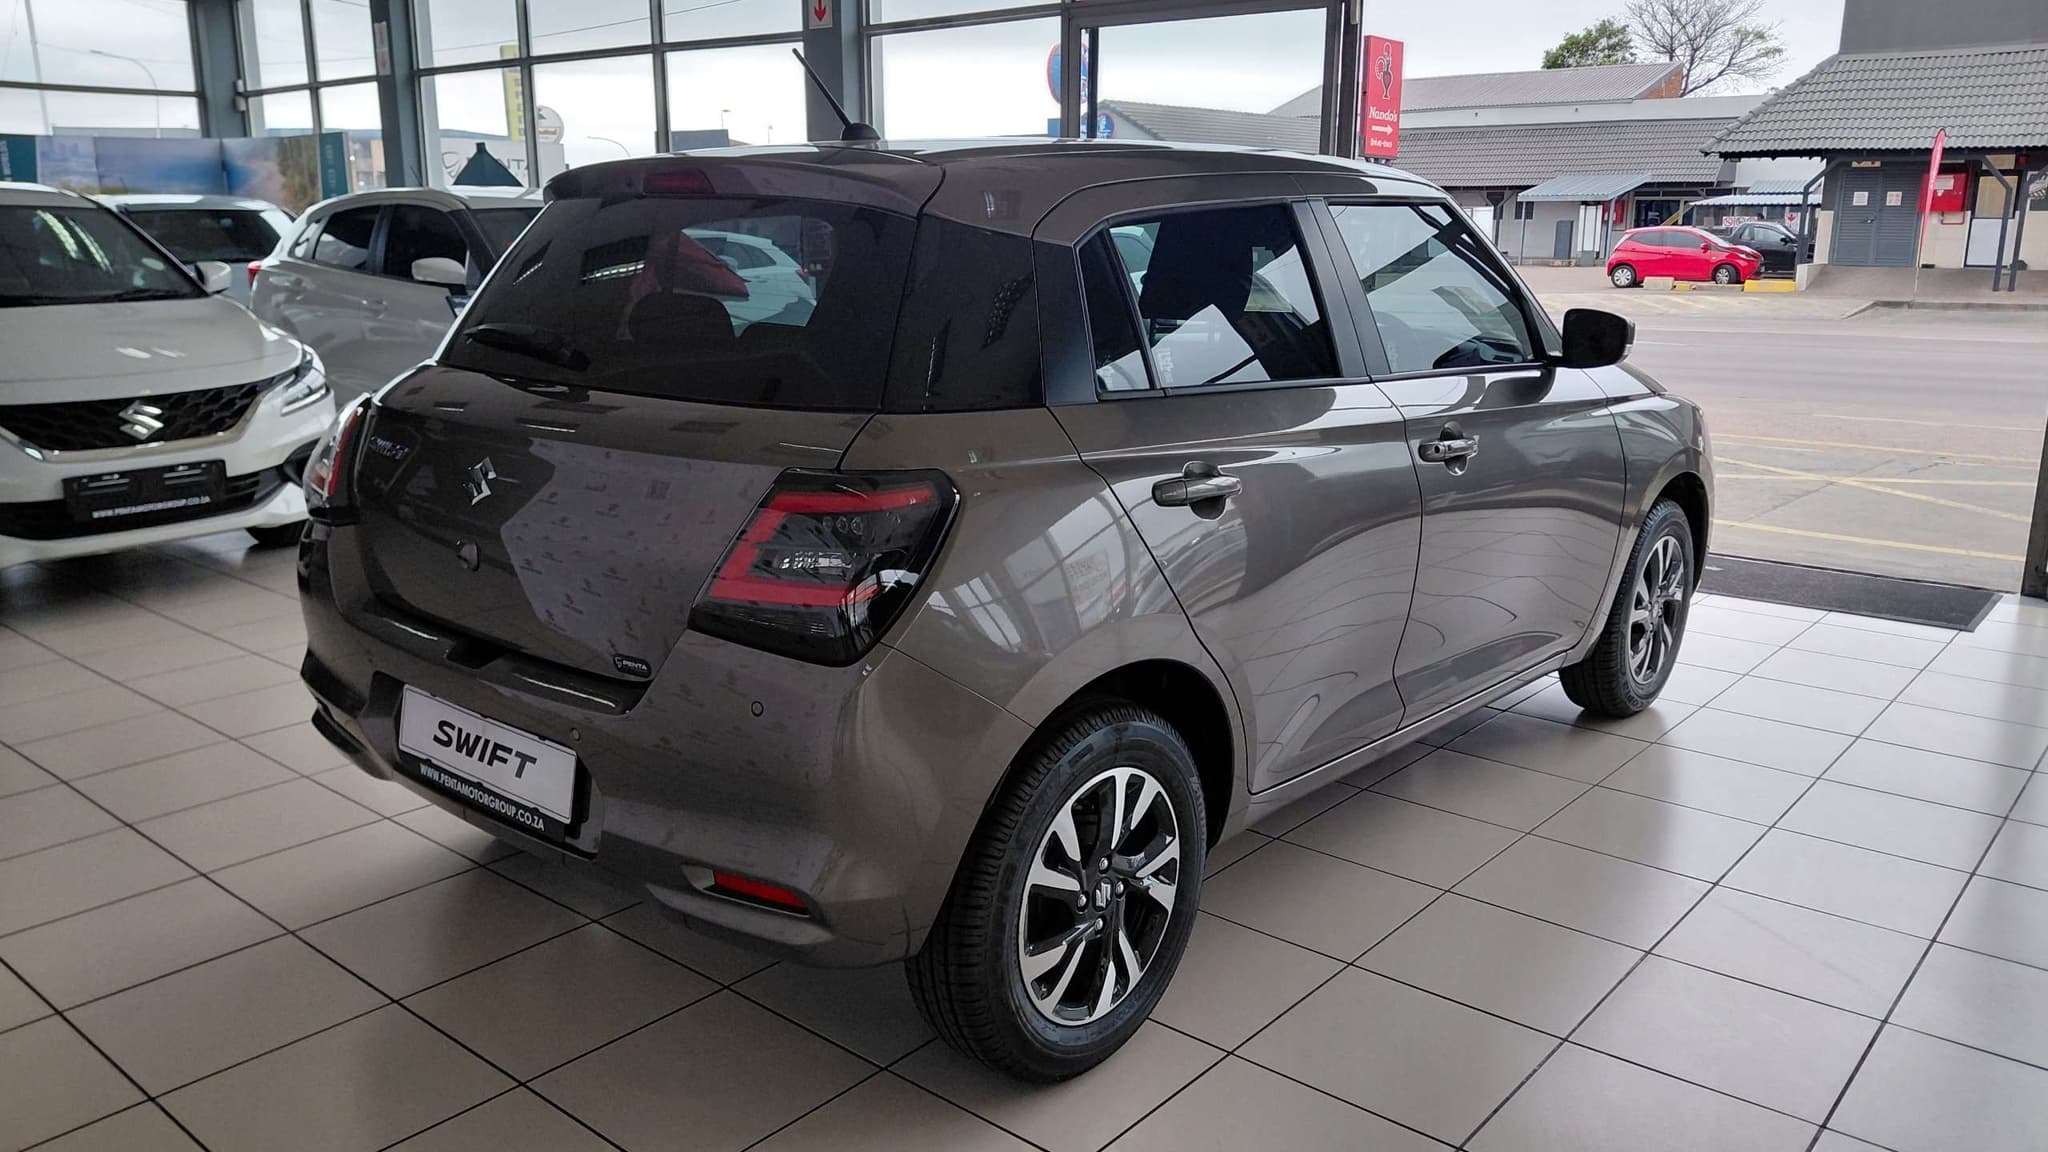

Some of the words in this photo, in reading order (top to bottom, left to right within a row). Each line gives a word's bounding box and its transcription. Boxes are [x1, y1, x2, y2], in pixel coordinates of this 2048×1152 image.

[1369, 106, 1398, 122] Nando's
[433, 720, 537, 779] SWIFT
[419, 763, 545, 831] WWW.PENTAMOTORGROUP.CO.ZA
